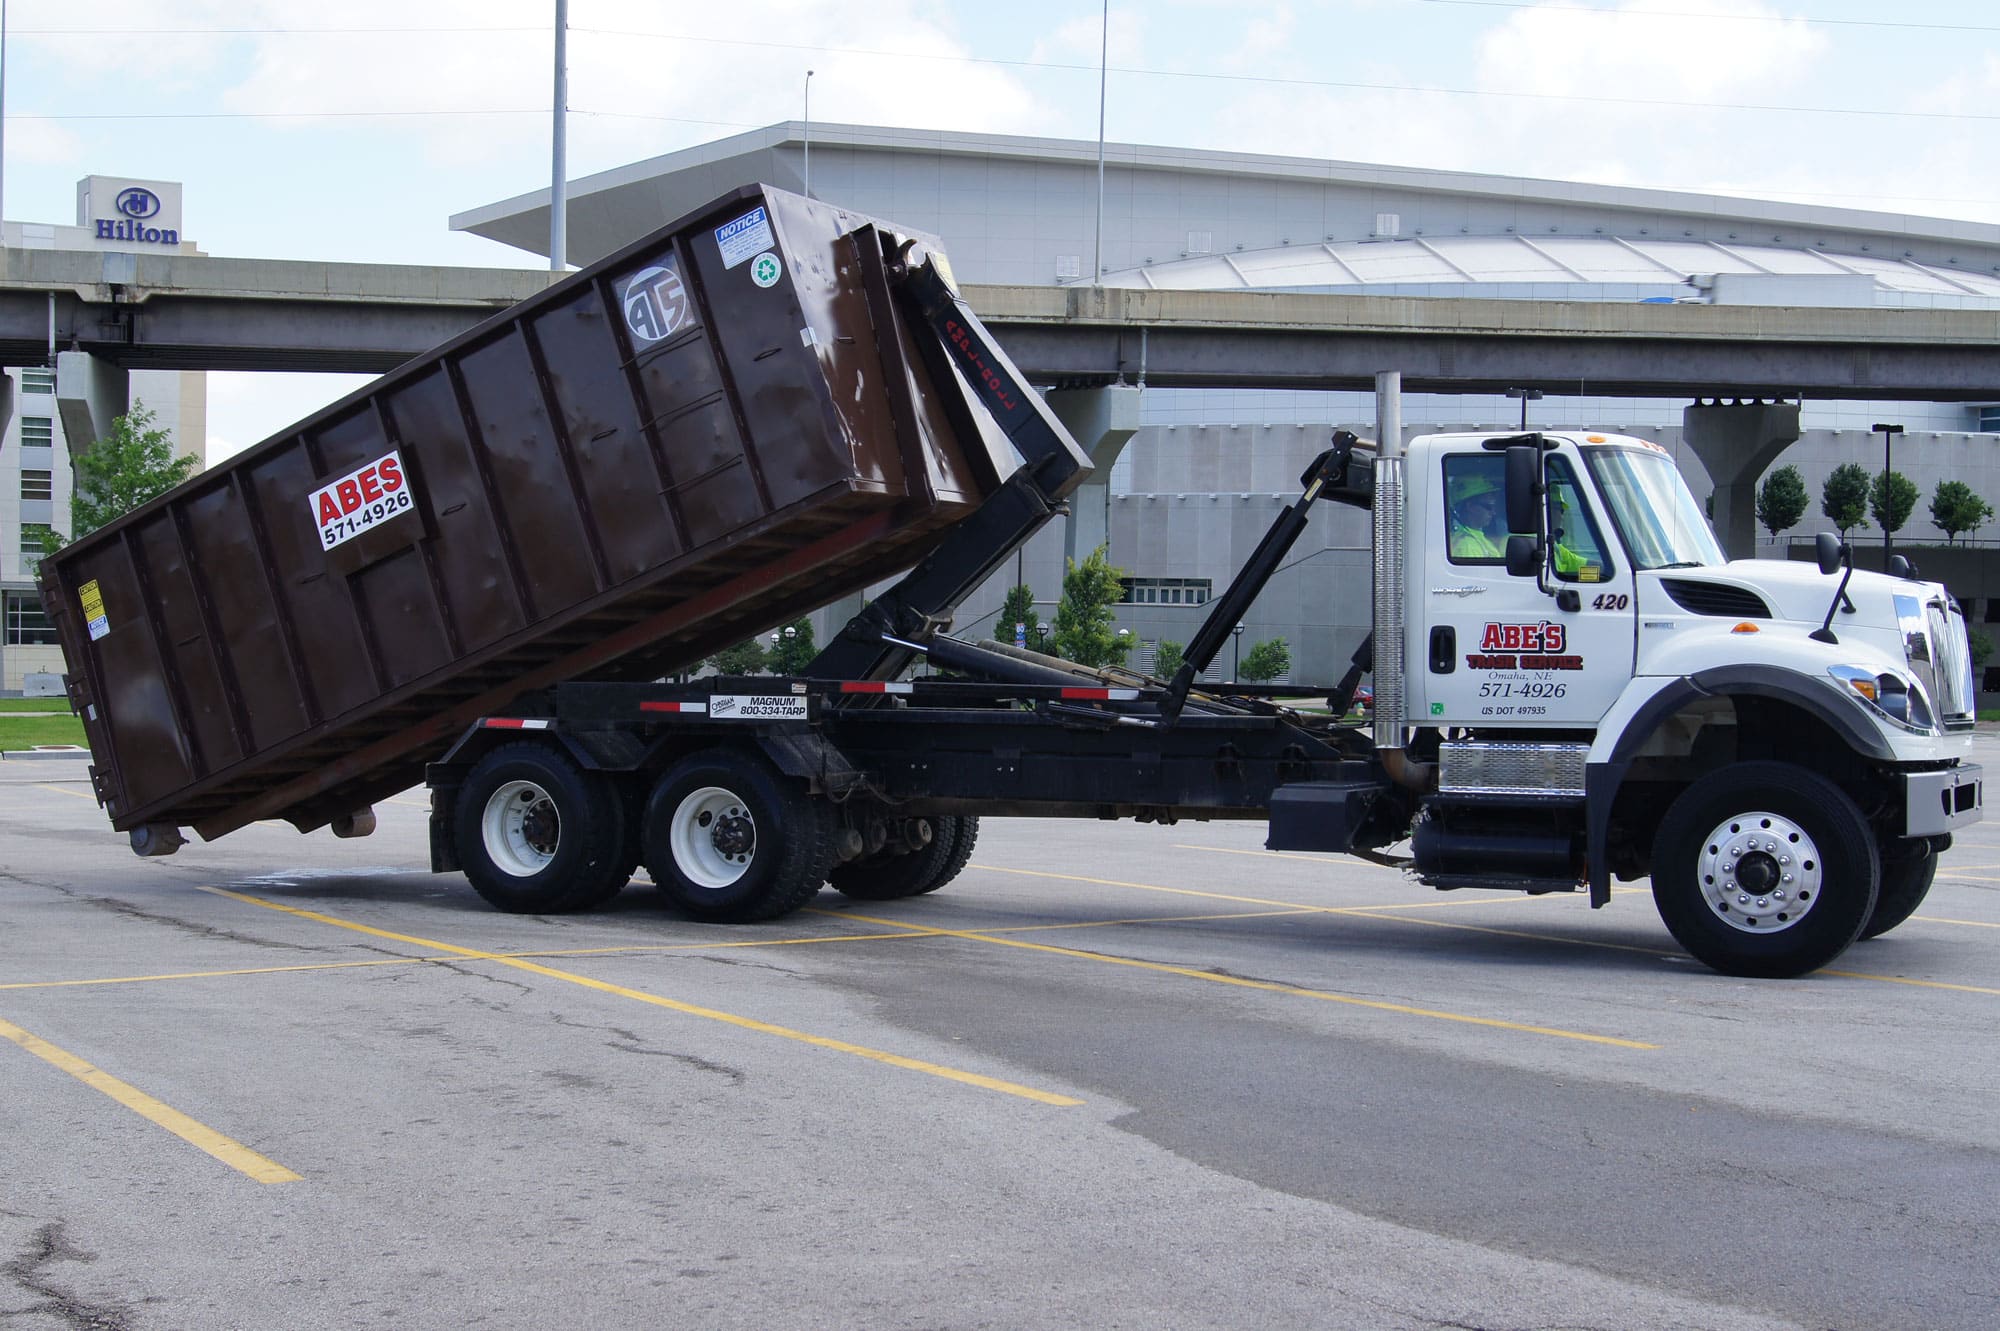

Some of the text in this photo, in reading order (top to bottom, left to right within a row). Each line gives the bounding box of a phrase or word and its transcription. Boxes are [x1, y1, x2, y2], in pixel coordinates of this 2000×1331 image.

[95, 218, 179, 245] Hilton
[721, 211, 761, 240] NOTICE
[625, 269, 685, 339] ATS
[946, 320, 1016, 410] AMPLIROLL
[319, 458, 403, 528] ABES
[324, 491, 409, 545] 571-4926
[1592, 594, 1628, 610] 420
[1480, 621, 1566, 654] ABE'S
[1466, 655, 1583, 670] TRASH SERVICE
[1488, 672, 1553, 681] Omaha, NE
[1479, 683, 1567, 698] 571-4926
[740, 706, 806, 716] 800-334-TARP
[750, 697, 796, 706] MAGNUM
[1481, 707, 1547, 715] US DOT 497935
